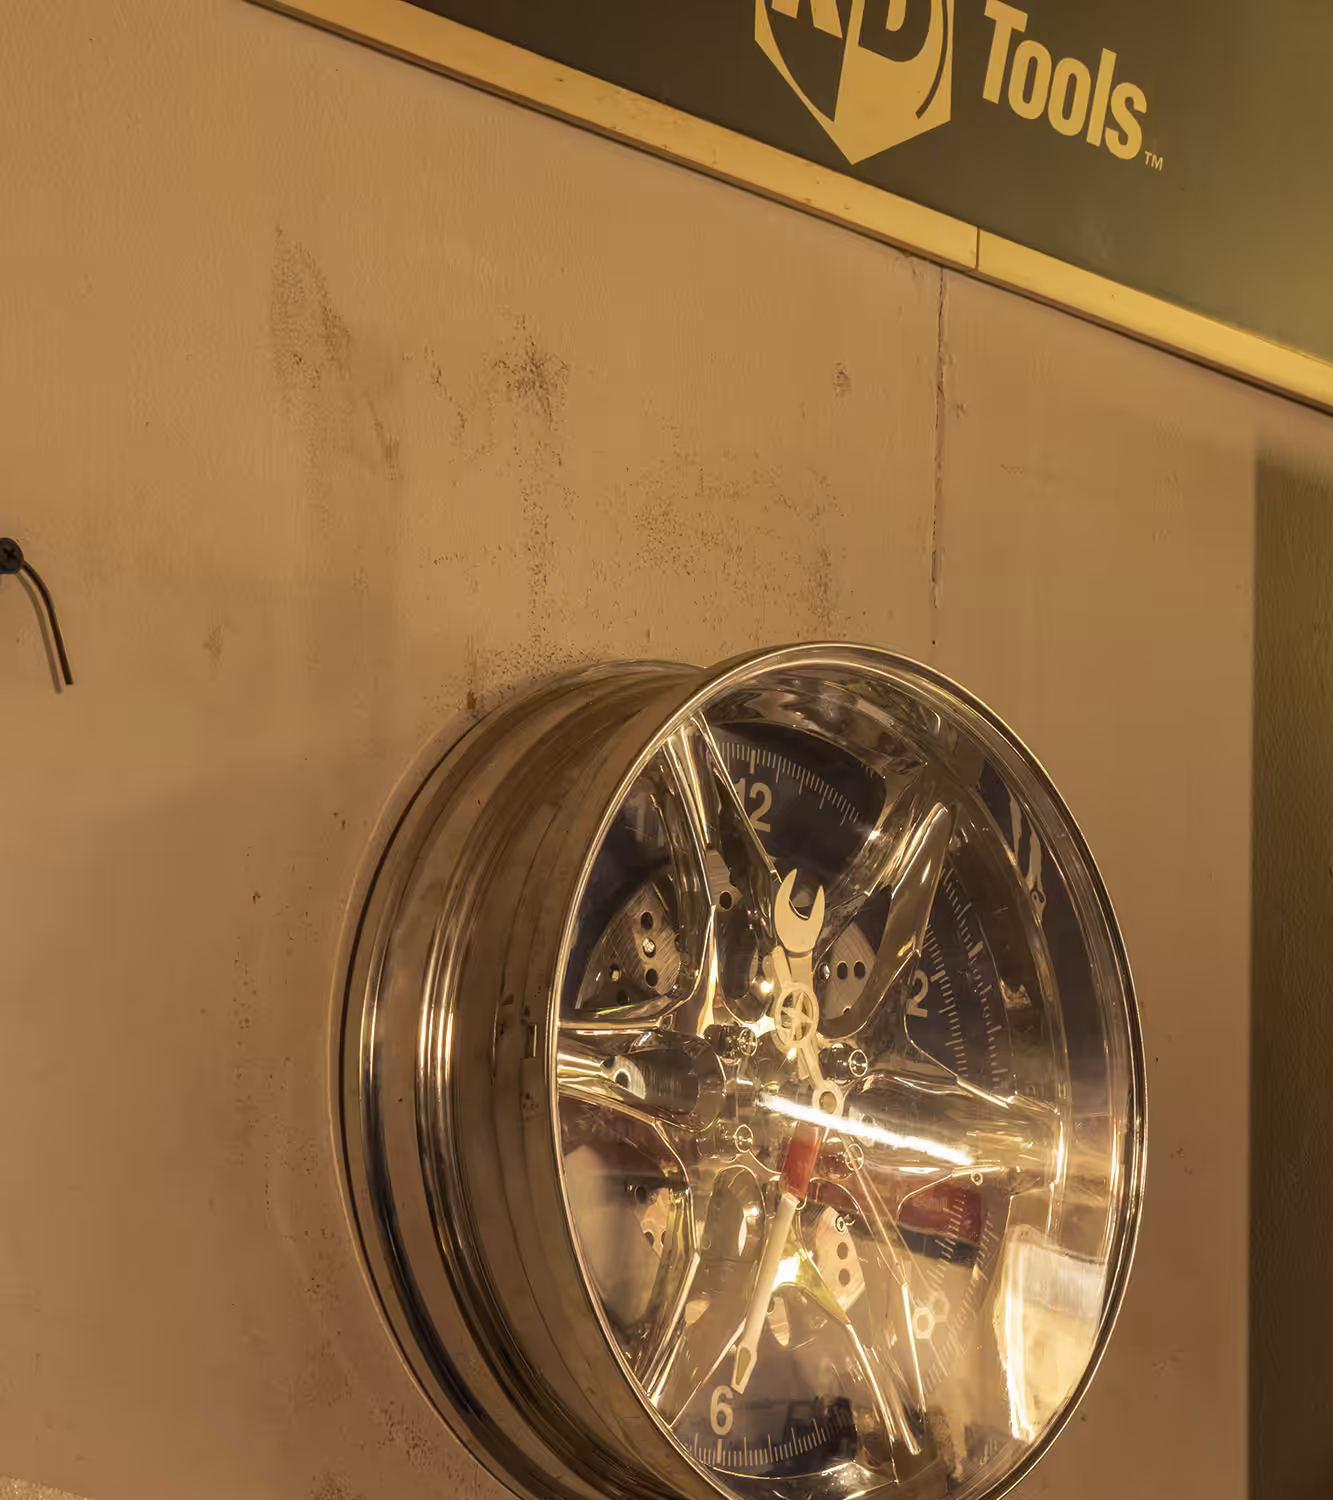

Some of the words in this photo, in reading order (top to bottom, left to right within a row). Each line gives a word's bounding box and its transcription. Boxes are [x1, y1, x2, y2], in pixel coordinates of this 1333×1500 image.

[982, 0, 1148, 161] Tools
[1144, 150, 1165, 171] TM
[710, 1386, 734, 1434] 6
